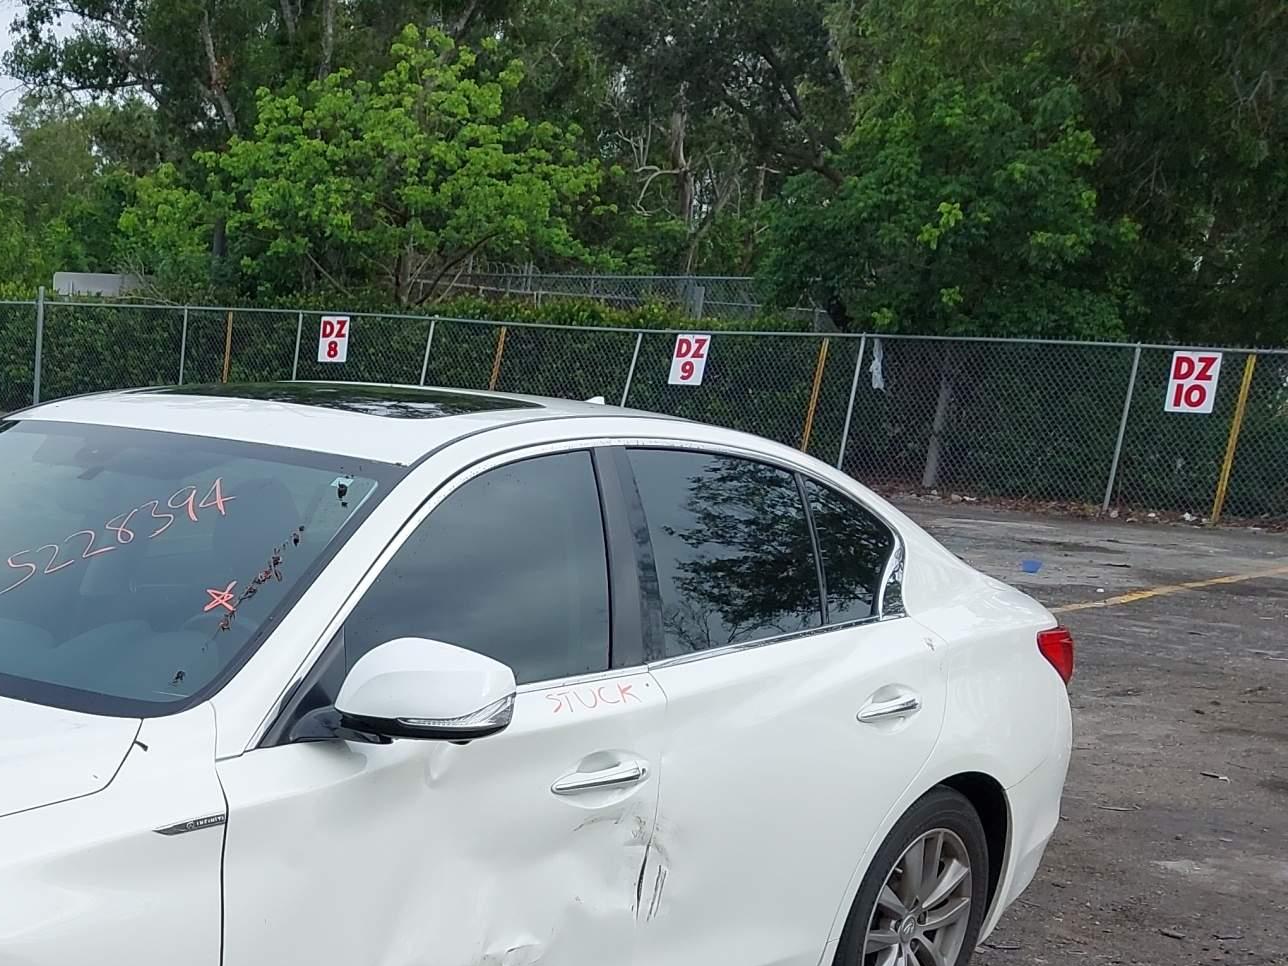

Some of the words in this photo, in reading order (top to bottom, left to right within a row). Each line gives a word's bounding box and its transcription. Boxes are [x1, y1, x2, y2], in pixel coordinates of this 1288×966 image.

[322, 320, 348, 338] DZ
[327, 340, 338, 358] 8
[676, 338, 707, 358] DZ
[680, 361, 694, 380] 9
[1173, 356, 1218, 381] DZ
[1173, 383, 1206, 407] 10
[544, 682, 642, 713] STUCK
